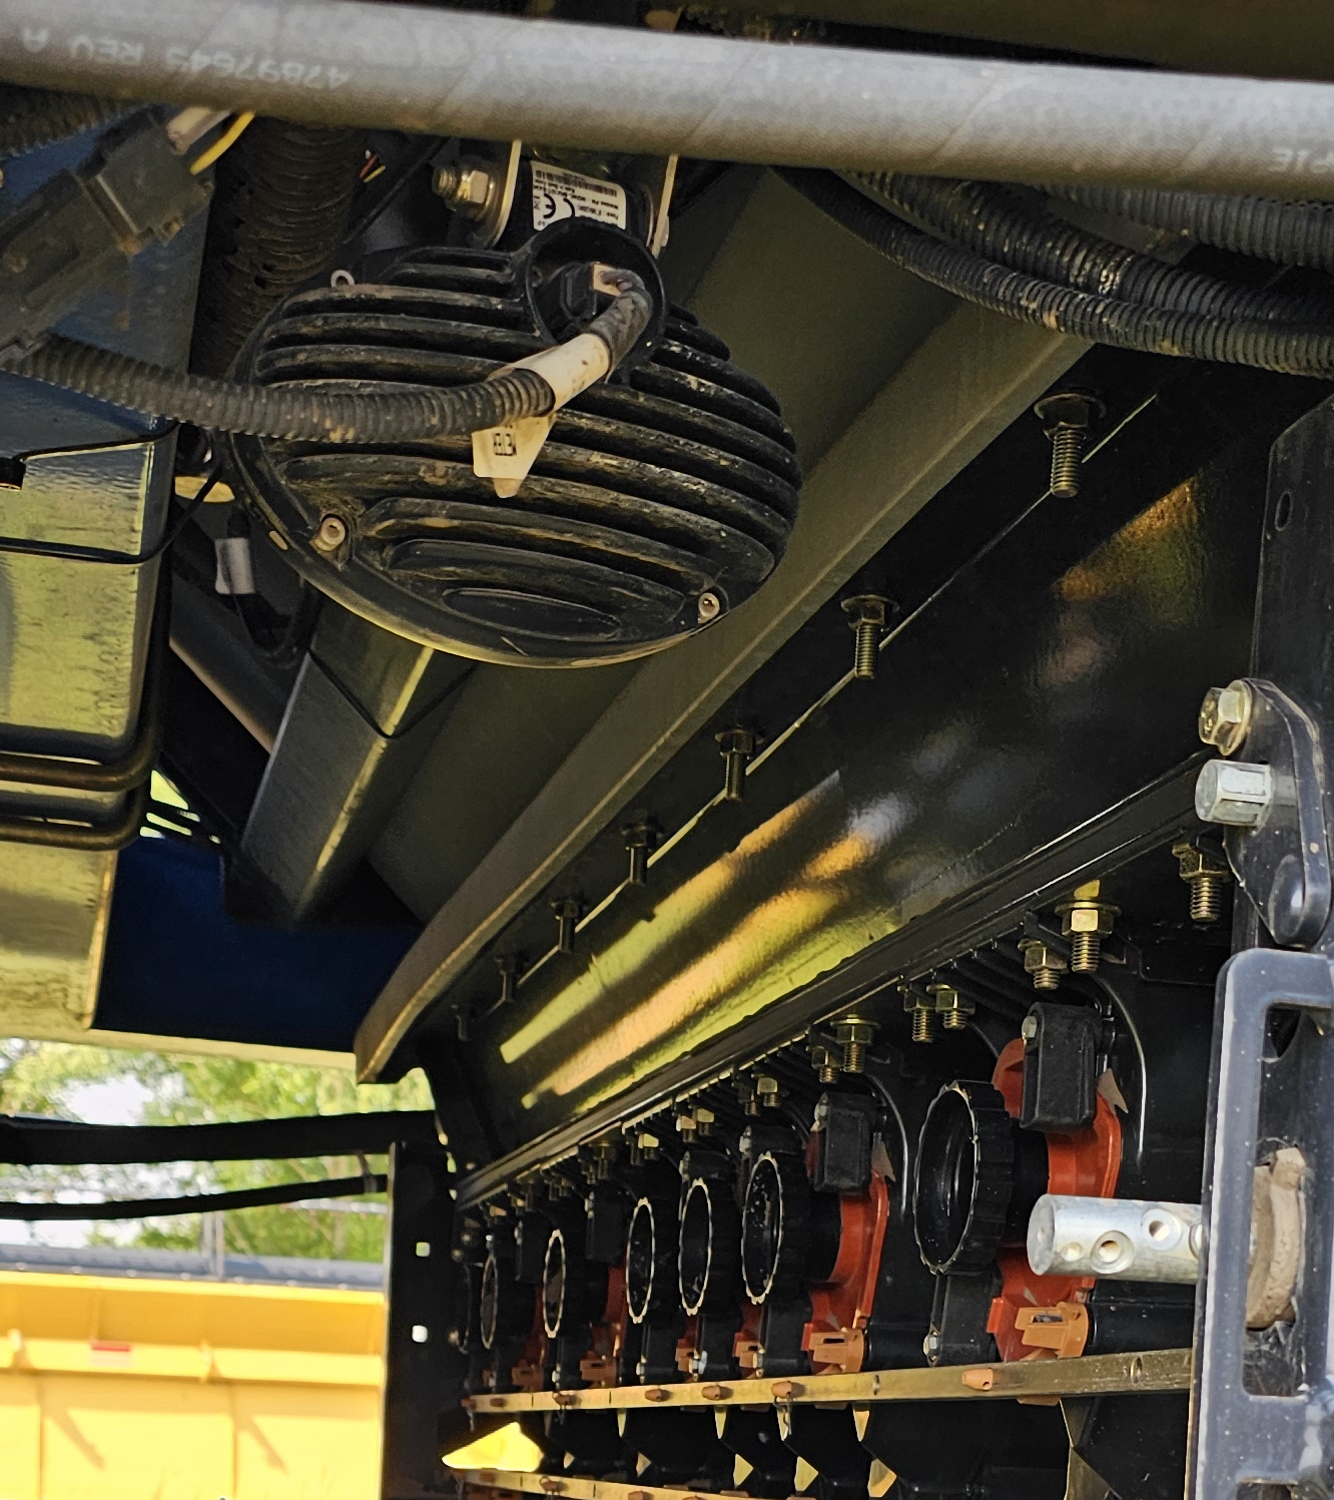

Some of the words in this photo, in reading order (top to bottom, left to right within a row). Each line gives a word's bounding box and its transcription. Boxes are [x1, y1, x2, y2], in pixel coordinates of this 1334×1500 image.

[22, 26, 49, 52] A
[69, 34, 144, 67] REV
[166, 46, 351, 91] 47897645
